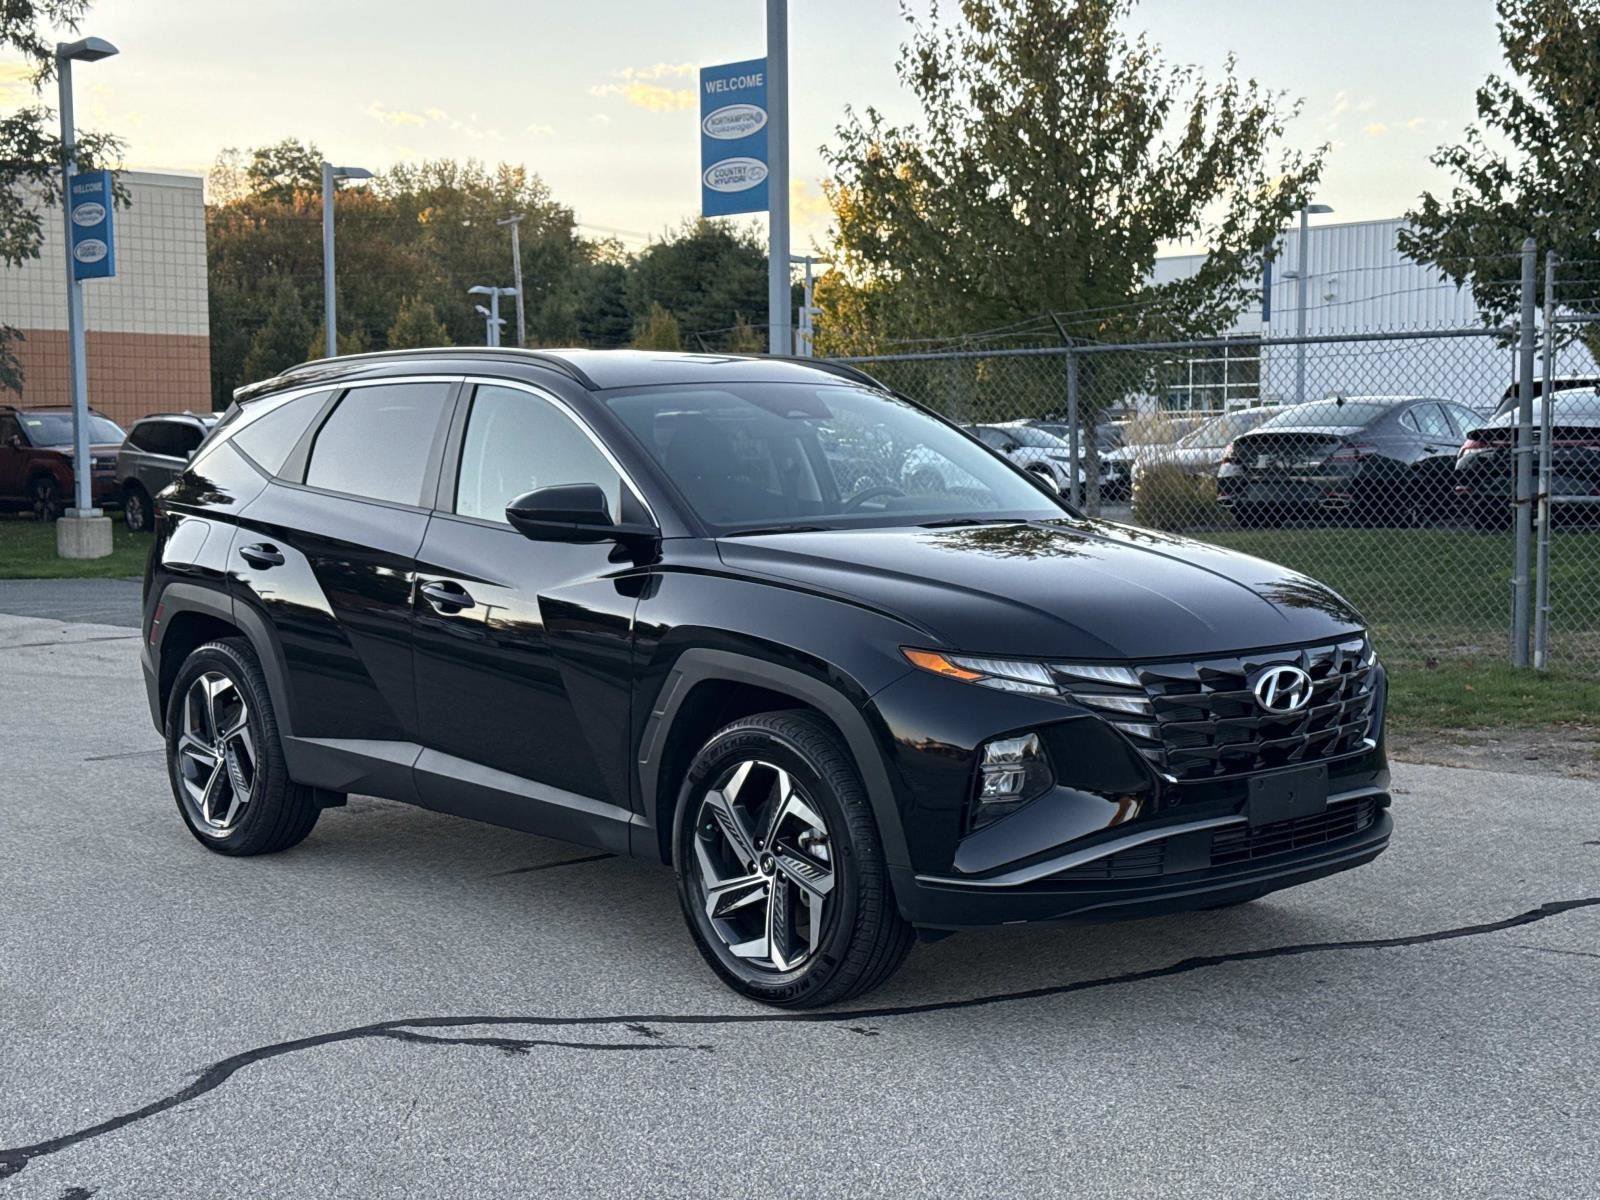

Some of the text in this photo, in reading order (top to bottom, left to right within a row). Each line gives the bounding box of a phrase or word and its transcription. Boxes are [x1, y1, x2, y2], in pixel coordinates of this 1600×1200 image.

[705, 73, 763, 94] WELCOME
[710, 112, 755, 125] NORTHAMPTON
[714, 166, 747, 178] COUNTRY
[714, 175, 746, 185] HYUNDAI
[73, 182, 102, 194] WELCOME
